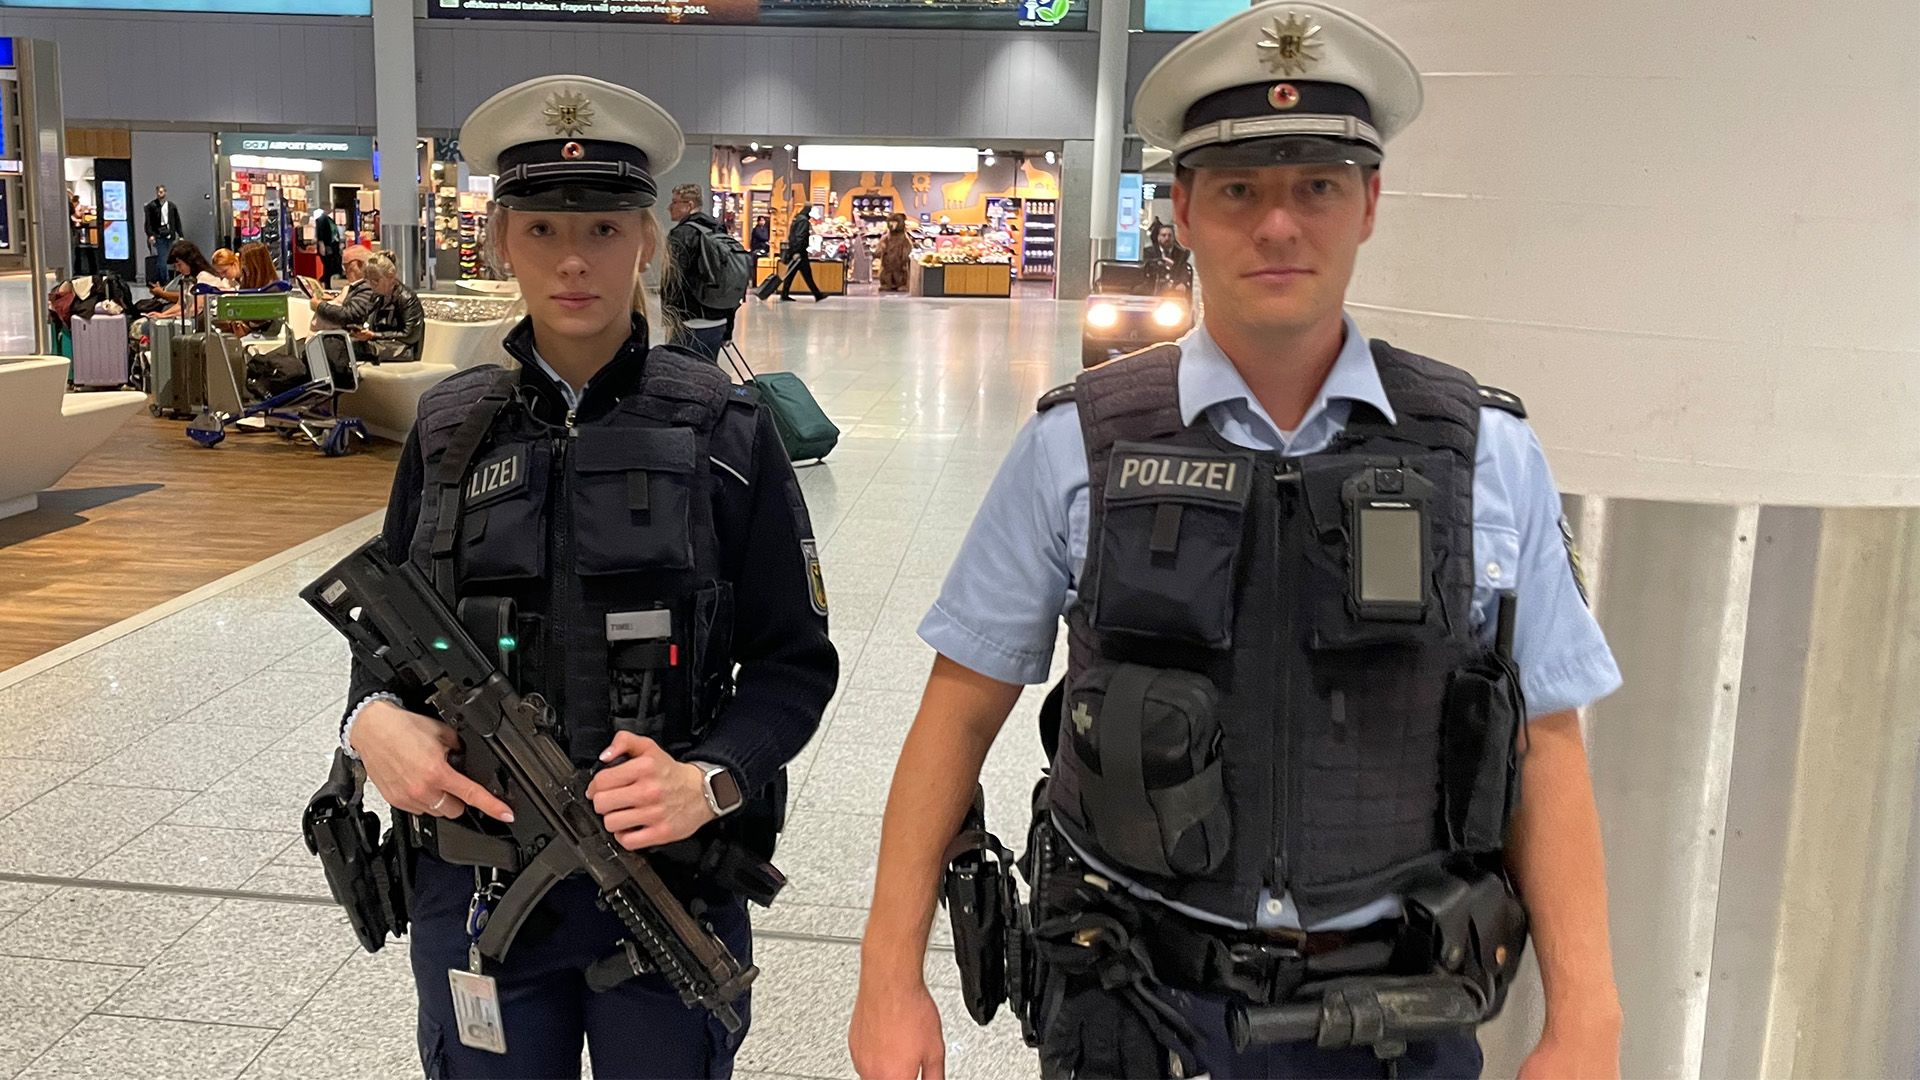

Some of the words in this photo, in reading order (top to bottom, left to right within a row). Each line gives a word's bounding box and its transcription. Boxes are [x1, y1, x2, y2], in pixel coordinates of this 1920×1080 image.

[463, 0, 498, 9] offshore
[499, 1, 521, 10] wind
[522, 2, 560, 11] turbines.
[560, 3, 592, 13] Fraport
[593, 4, 609, 12] will
[610, 5, 621, 14] go
[622, 4, 670, 13] carbon-free
[671, 5, 683, 15] by
[684, 5, 709, 14] 2045.
[269, 141, 305, 150] AIRPORT
[305, 142, 349, 151] SHOPPING
[1119, 459, 1236, 492] POLIZEI
